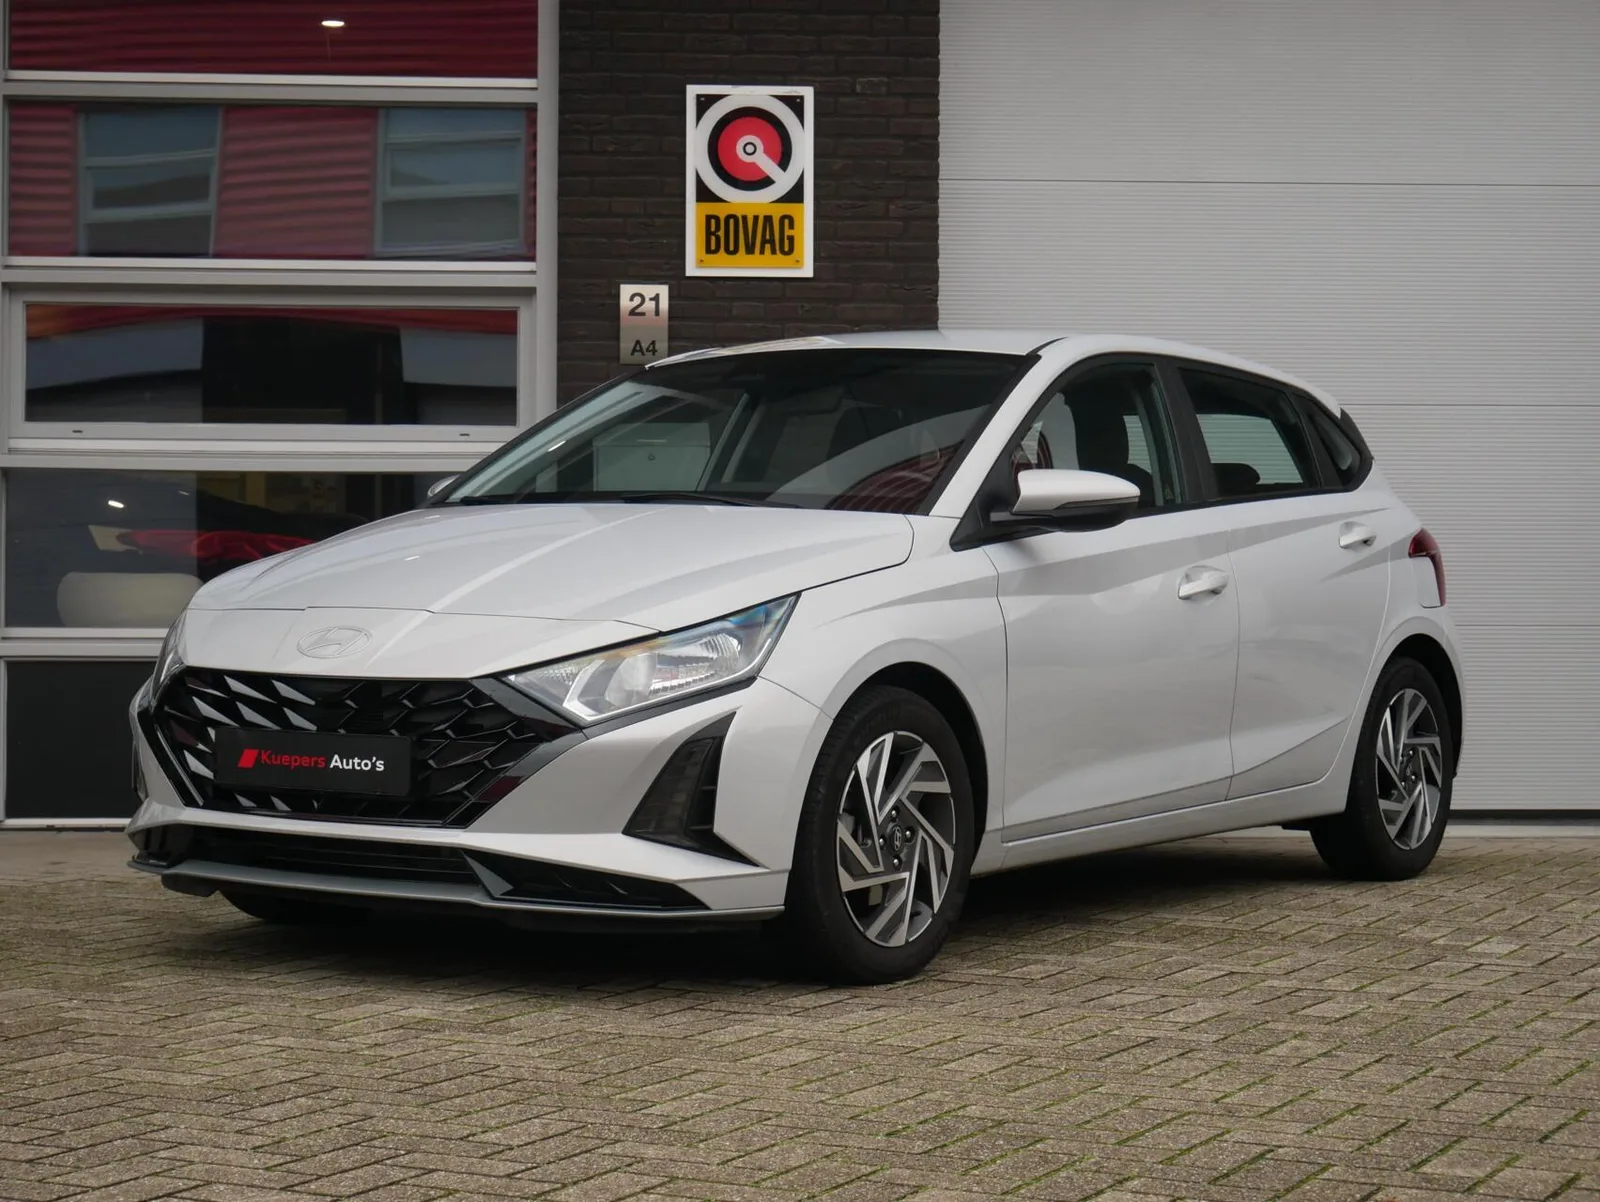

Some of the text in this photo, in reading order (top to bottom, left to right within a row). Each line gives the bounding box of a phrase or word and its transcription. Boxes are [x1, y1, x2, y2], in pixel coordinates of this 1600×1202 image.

[705, 213, 795, 256] BOVAG
[628, 292, 660, 317] 21
[630, 339, 658, 356] A4
[260, 750, 385, 772] Kuepers Auto's
